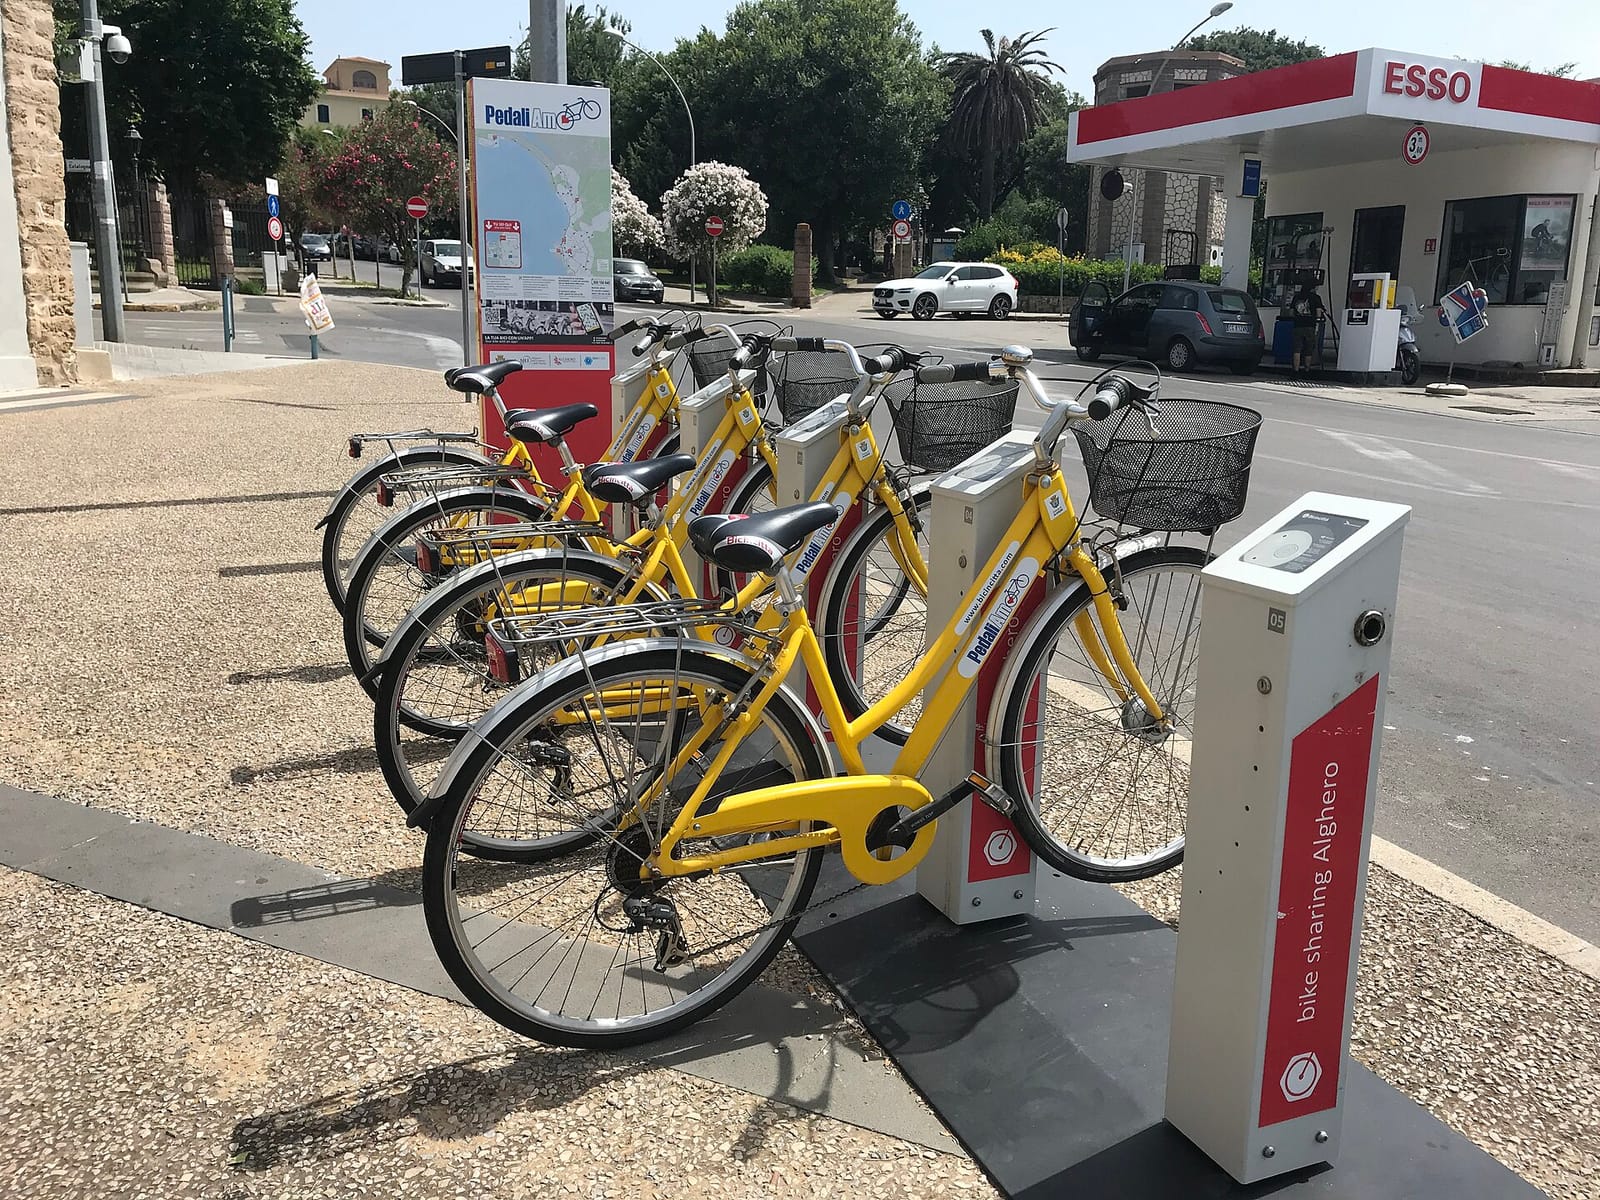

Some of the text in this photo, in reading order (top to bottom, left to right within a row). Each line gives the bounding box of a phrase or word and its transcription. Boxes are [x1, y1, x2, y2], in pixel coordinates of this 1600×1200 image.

[1384, 61, 1471, 104] ESSO
[963, 552, 1014, 624] www.bicincitta.com
[1269, 612, 1285, 630] 05
[1296, 760, 1340, 1024] bike sharing Alghero
